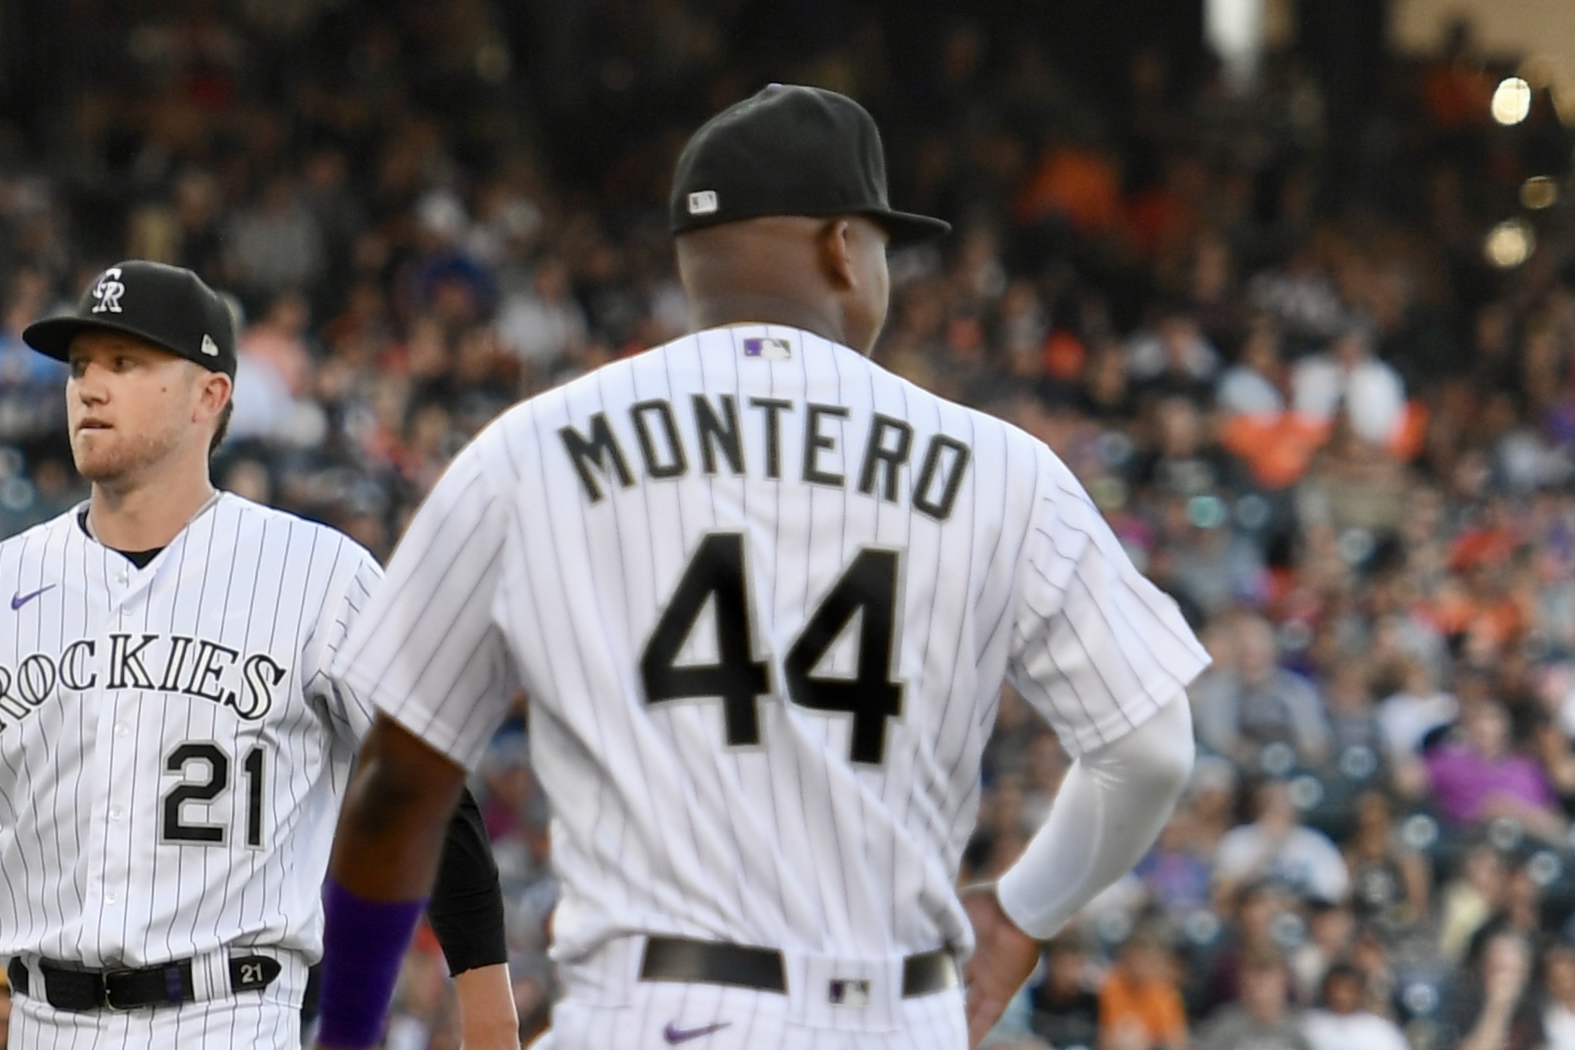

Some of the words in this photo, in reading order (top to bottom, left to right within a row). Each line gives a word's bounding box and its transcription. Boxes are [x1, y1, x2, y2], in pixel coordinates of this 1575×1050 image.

[558, 393, 971, 522] MONTERO
[638, 527, 910, 772] 44
[159, 739, 267, 851] 21
[240, 962, 263, 984] 21
